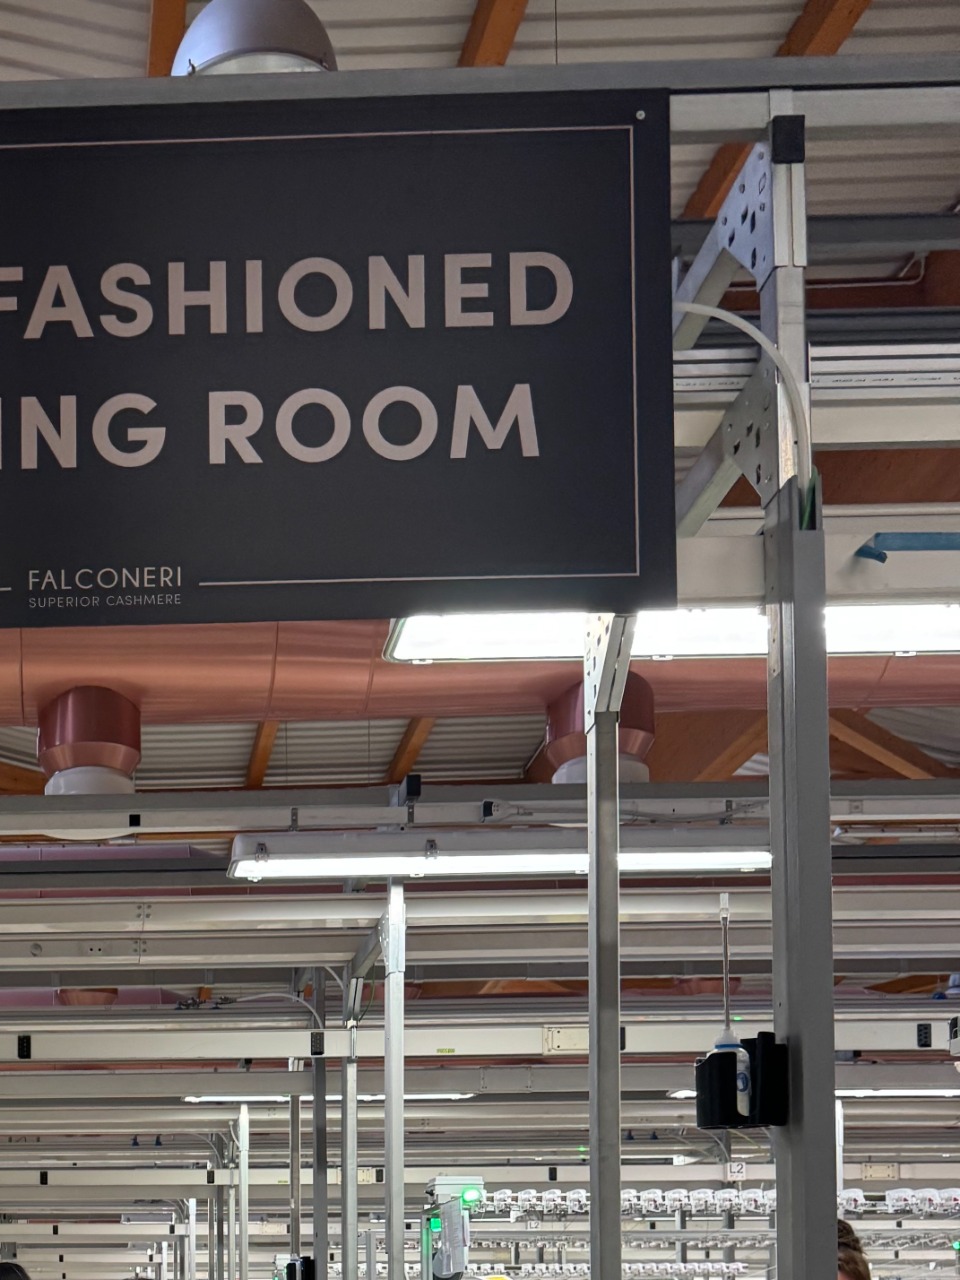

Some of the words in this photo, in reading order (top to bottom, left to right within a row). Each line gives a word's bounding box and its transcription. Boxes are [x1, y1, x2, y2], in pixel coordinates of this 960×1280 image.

[208, 383, 540, 465] ROOM
[28, 566, 182, 591] FALCONERI
[28, 596, 100, 609] SUPERIOR
[105, 593, 182, 607] CASHMERE
[729, 1162, 744, 1174] L2
